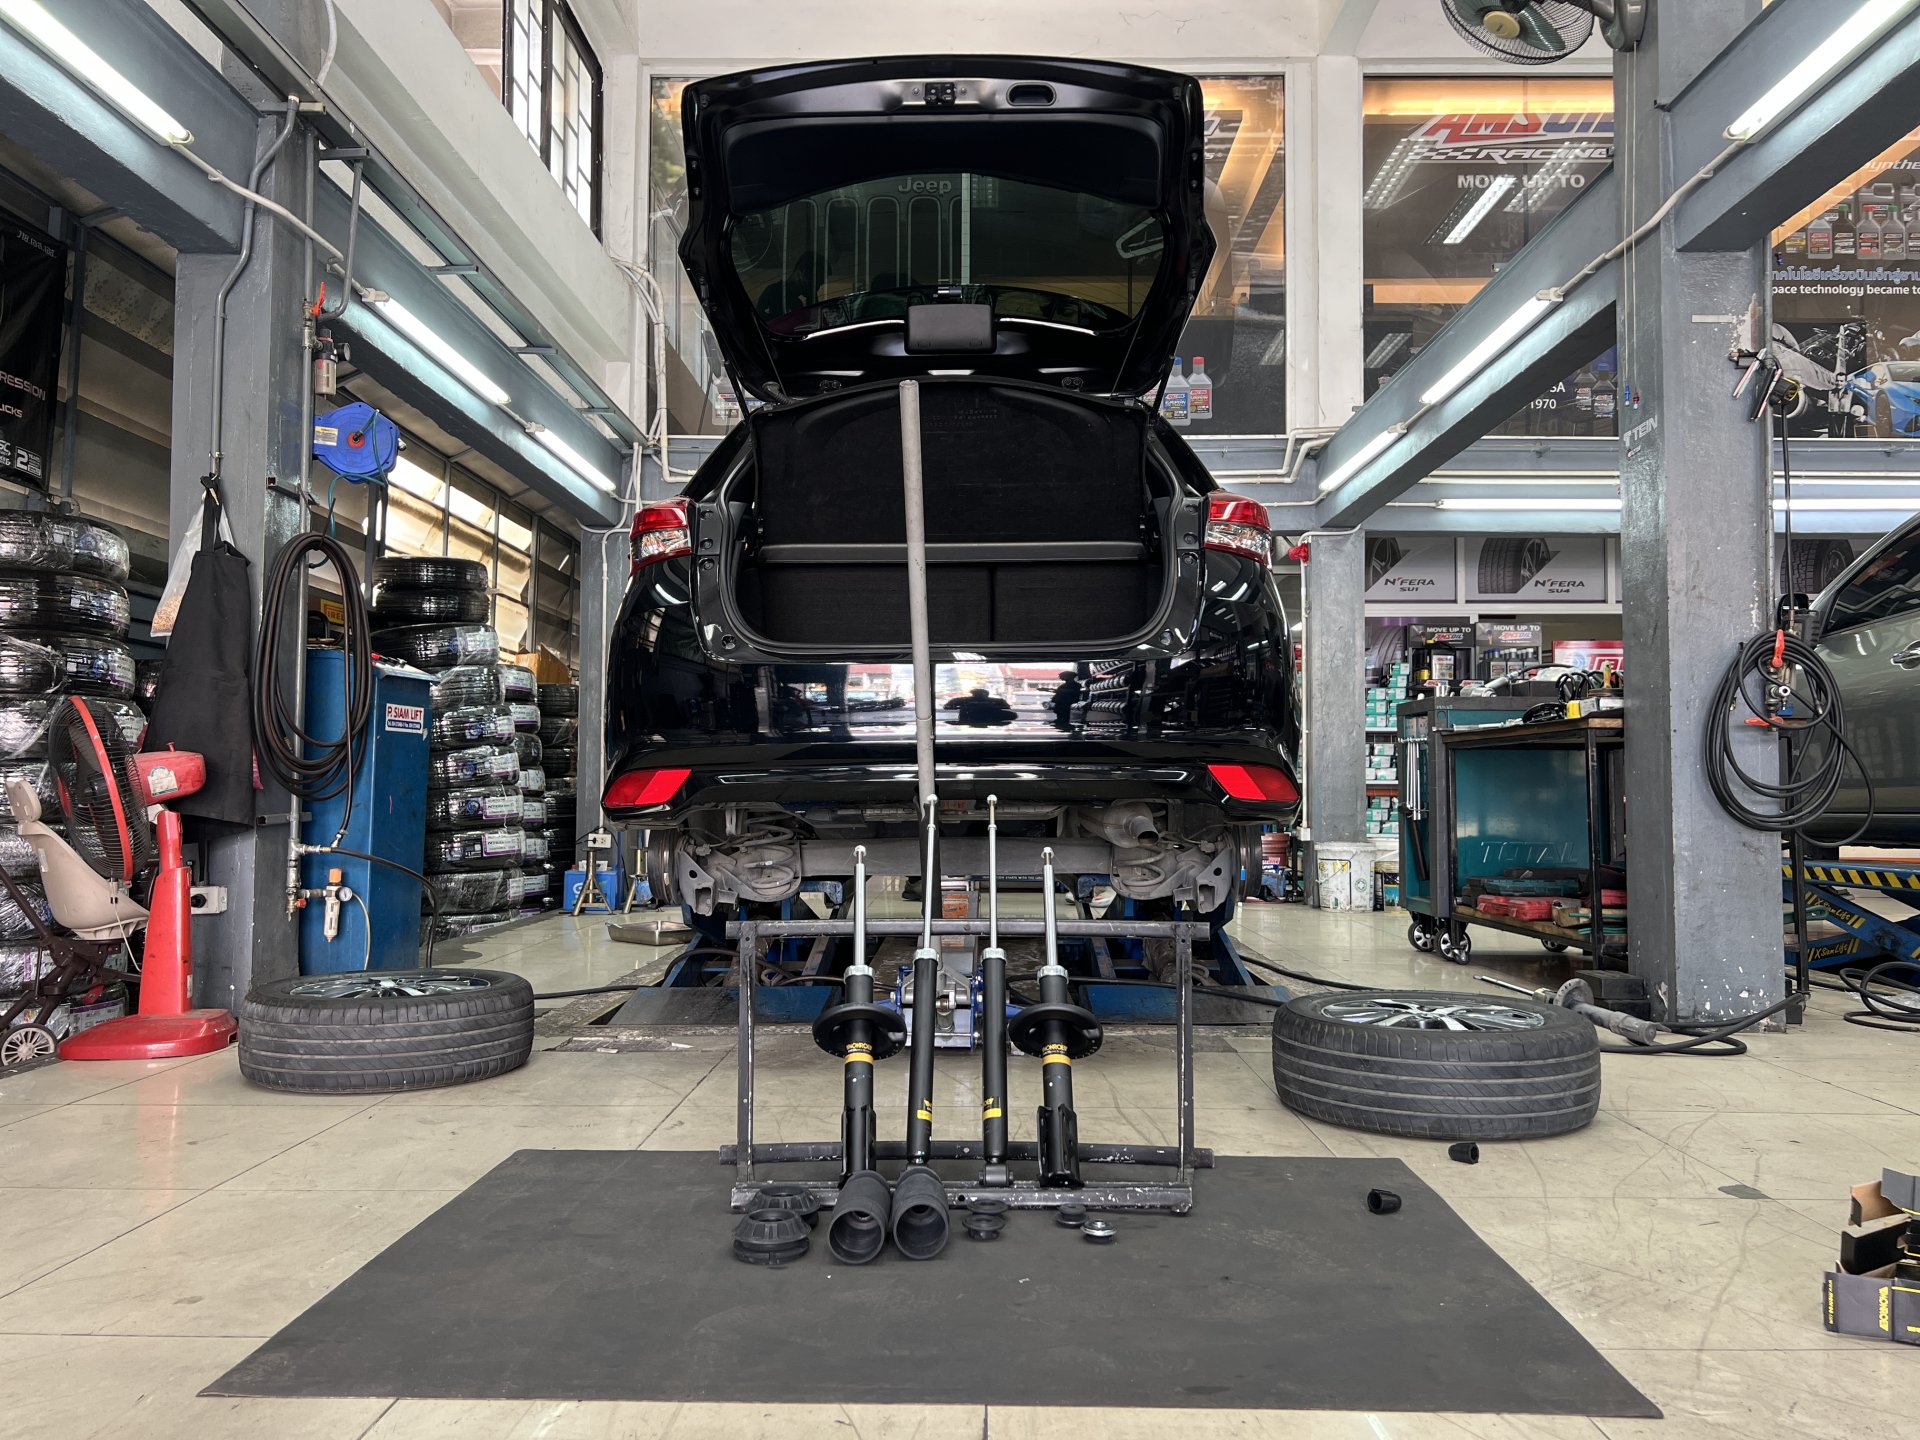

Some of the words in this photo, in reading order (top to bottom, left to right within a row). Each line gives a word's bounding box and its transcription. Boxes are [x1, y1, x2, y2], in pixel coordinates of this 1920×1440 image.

[898, 176, 952, 194] Jeep
[1559, 174, 1585, 188] TO
[1800, 284, 1864, 296] technology
[1867, 285, 1909, 294] became
[1530, 398, 1557, 409] 1970
[17, 449, 29, 471] 2
[394, 706, 410, 719] SIAM
[410, 709, 423, 721] LIFT
[1879, 1286, 1889, 1332] MONROE
